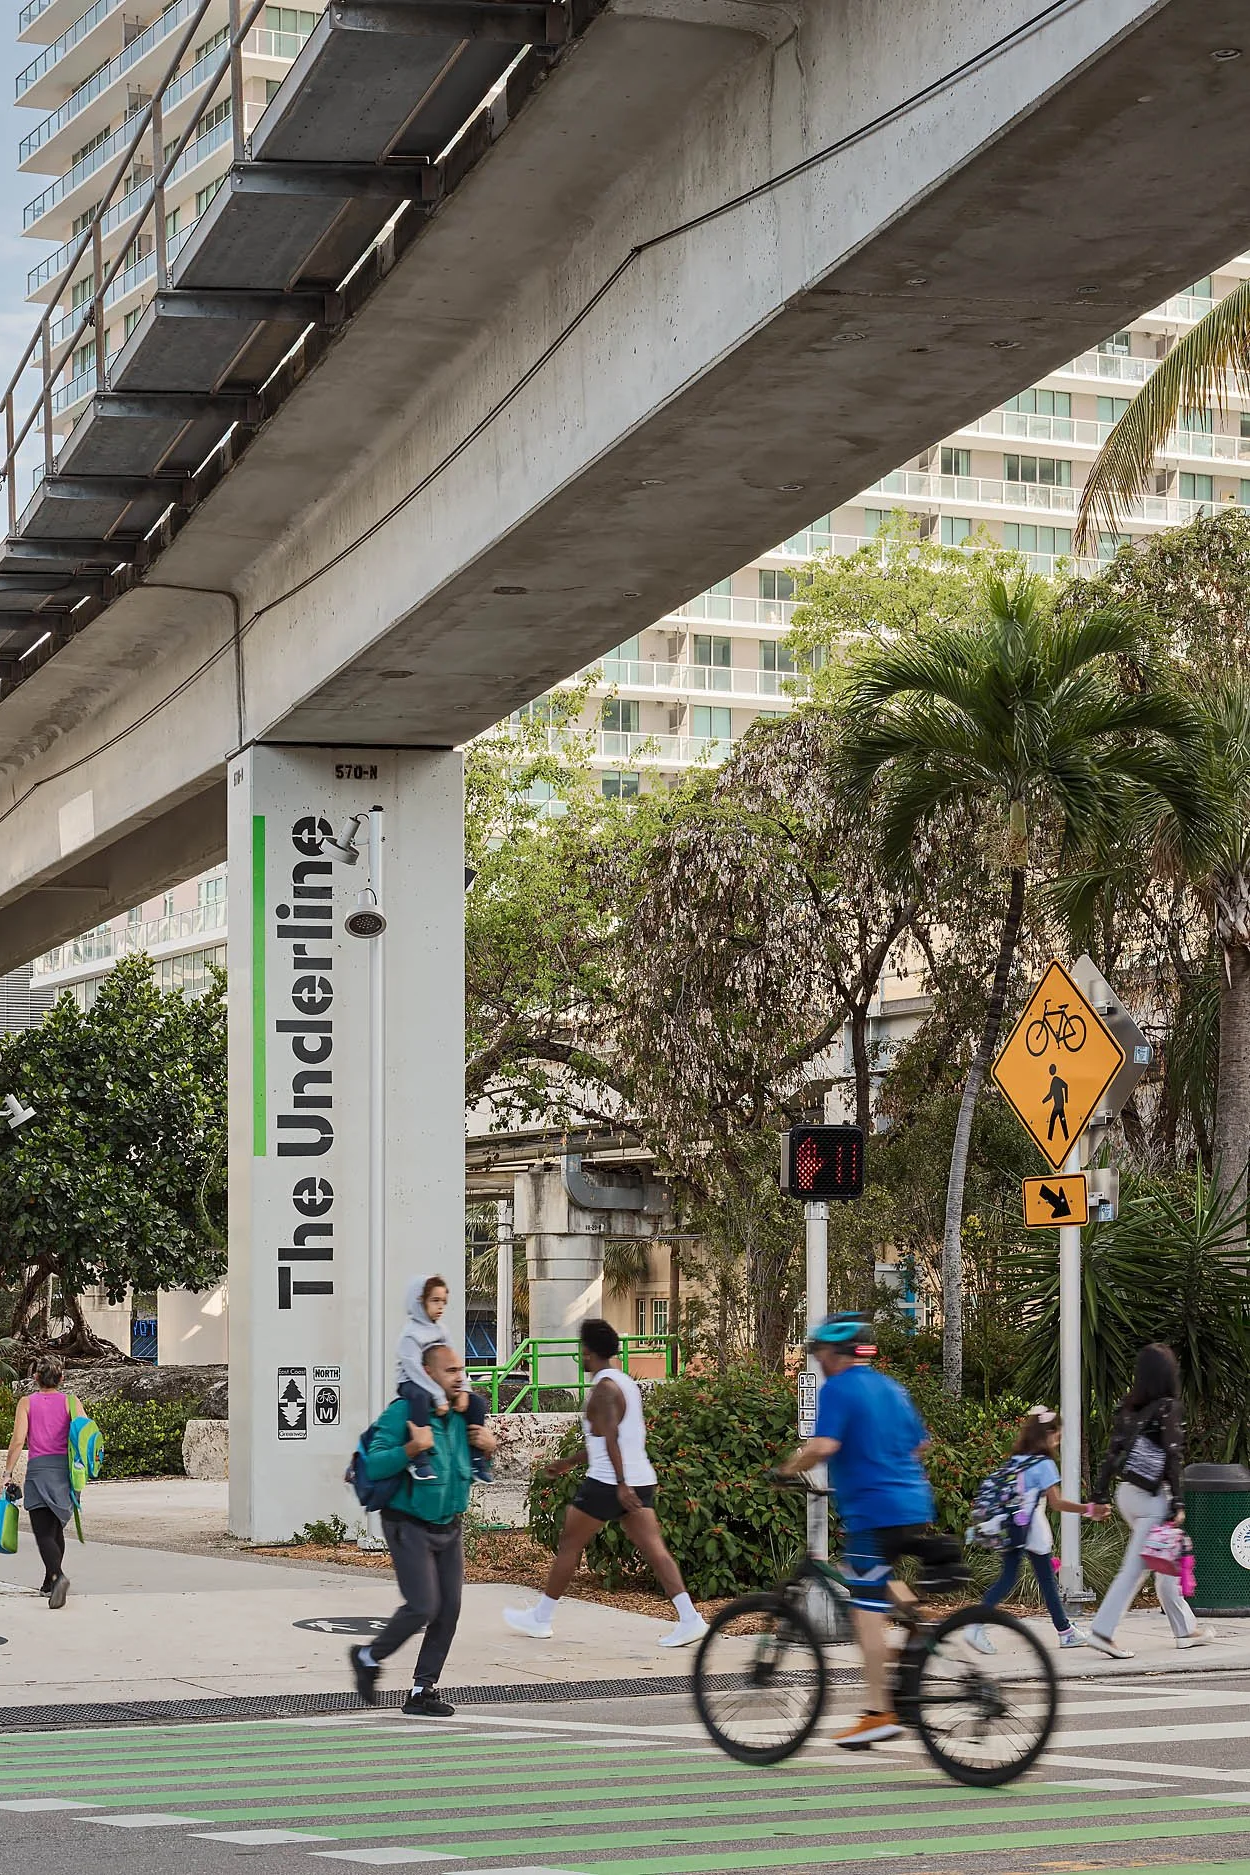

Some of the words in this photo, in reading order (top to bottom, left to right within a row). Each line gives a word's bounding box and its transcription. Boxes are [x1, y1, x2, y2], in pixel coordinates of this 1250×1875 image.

[335, 764, 378, 780] 570-N
[275, 815, 335, 1157] Underline
[277, 1176, 335, 1310] The
[315, 1368, 339, 1378] NORTH
[319, 1407, 333, 1420] M
